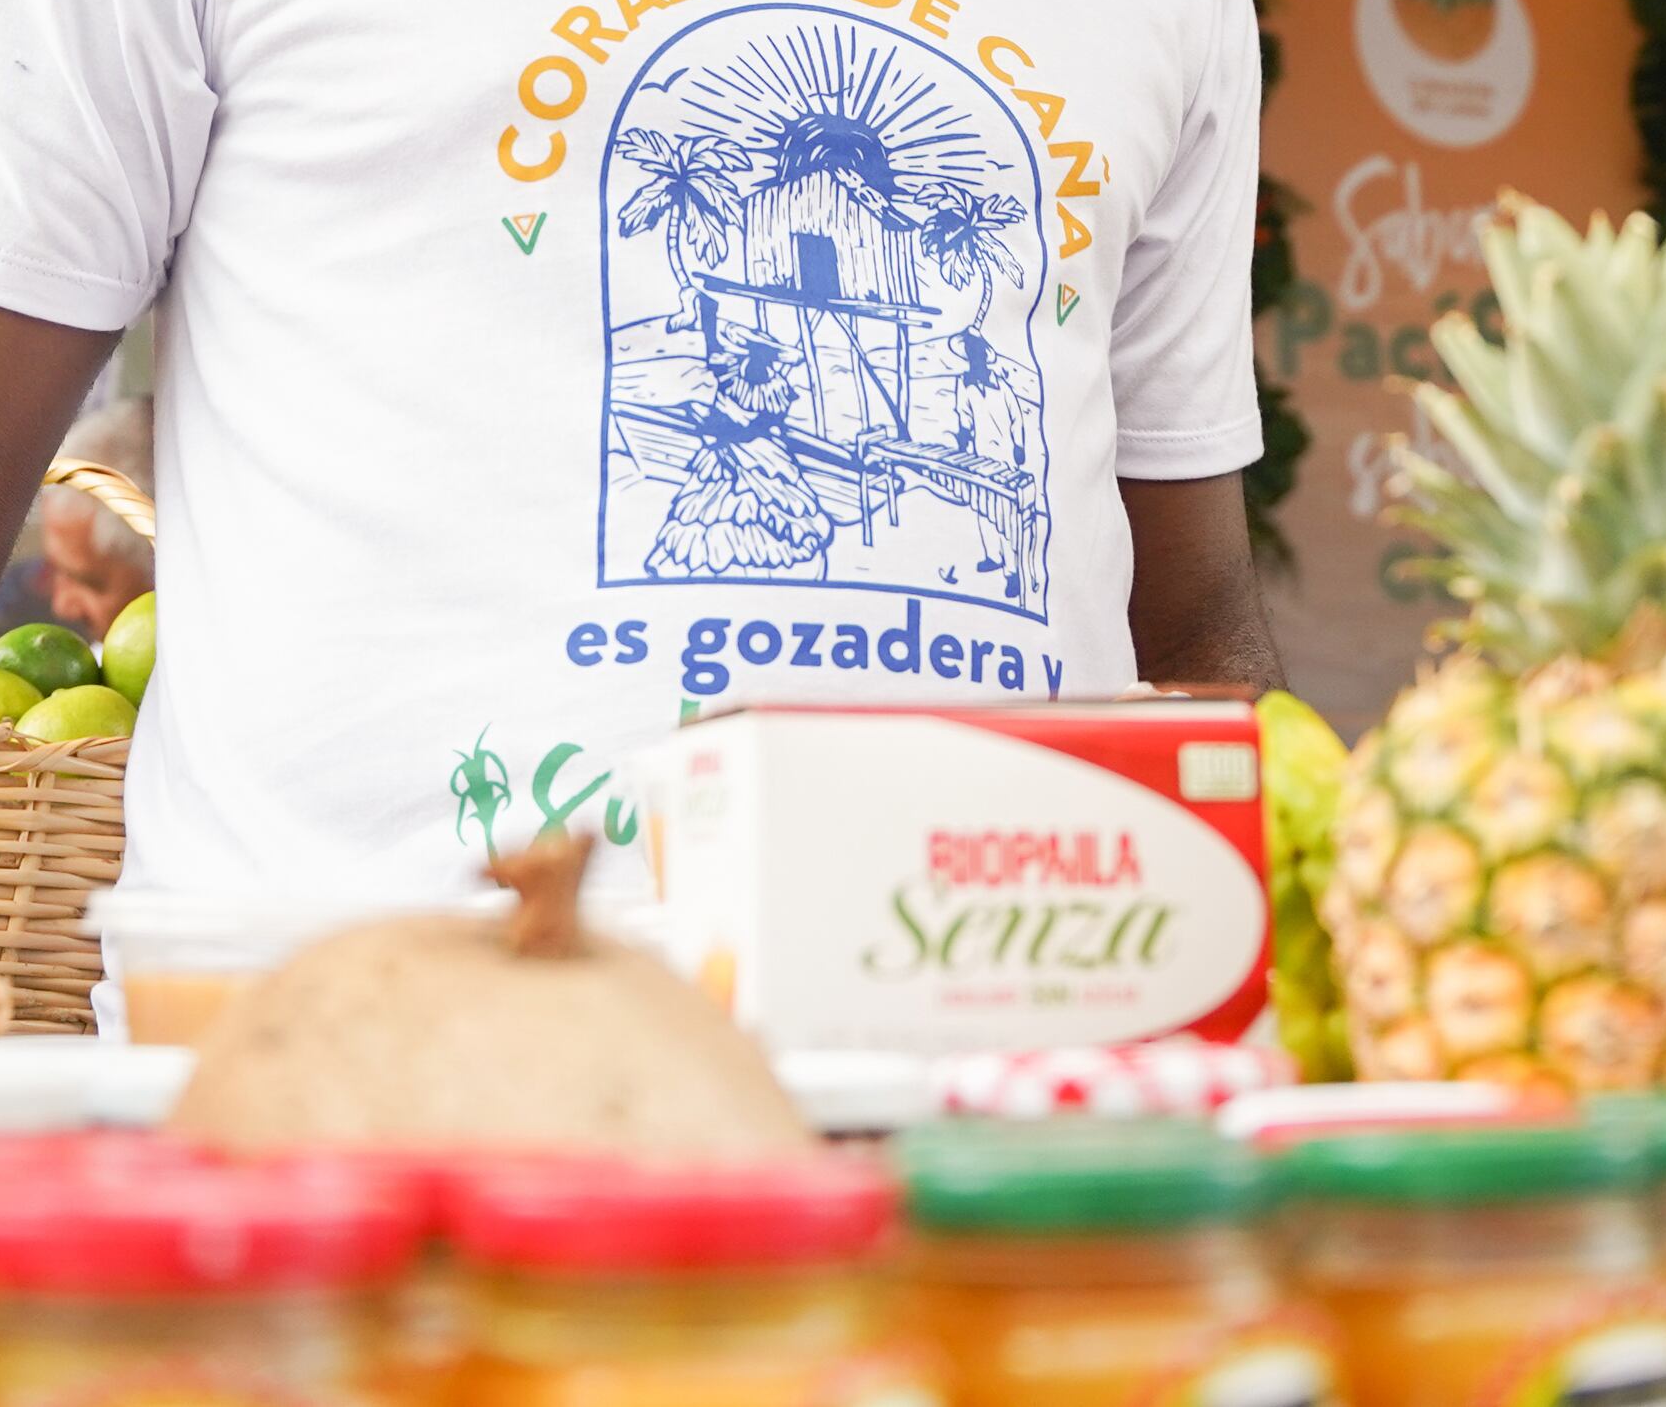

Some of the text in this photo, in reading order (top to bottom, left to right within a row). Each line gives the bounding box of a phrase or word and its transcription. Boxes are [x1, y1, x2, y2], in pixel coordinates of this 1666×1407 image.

[975, 34, 1111, 260] CAÑA
[566, 598, 1063, 703] es gozadera y
[926, 829, 1144, 886] RIOPAILA
[860, 880, 1183, 982] Senza
